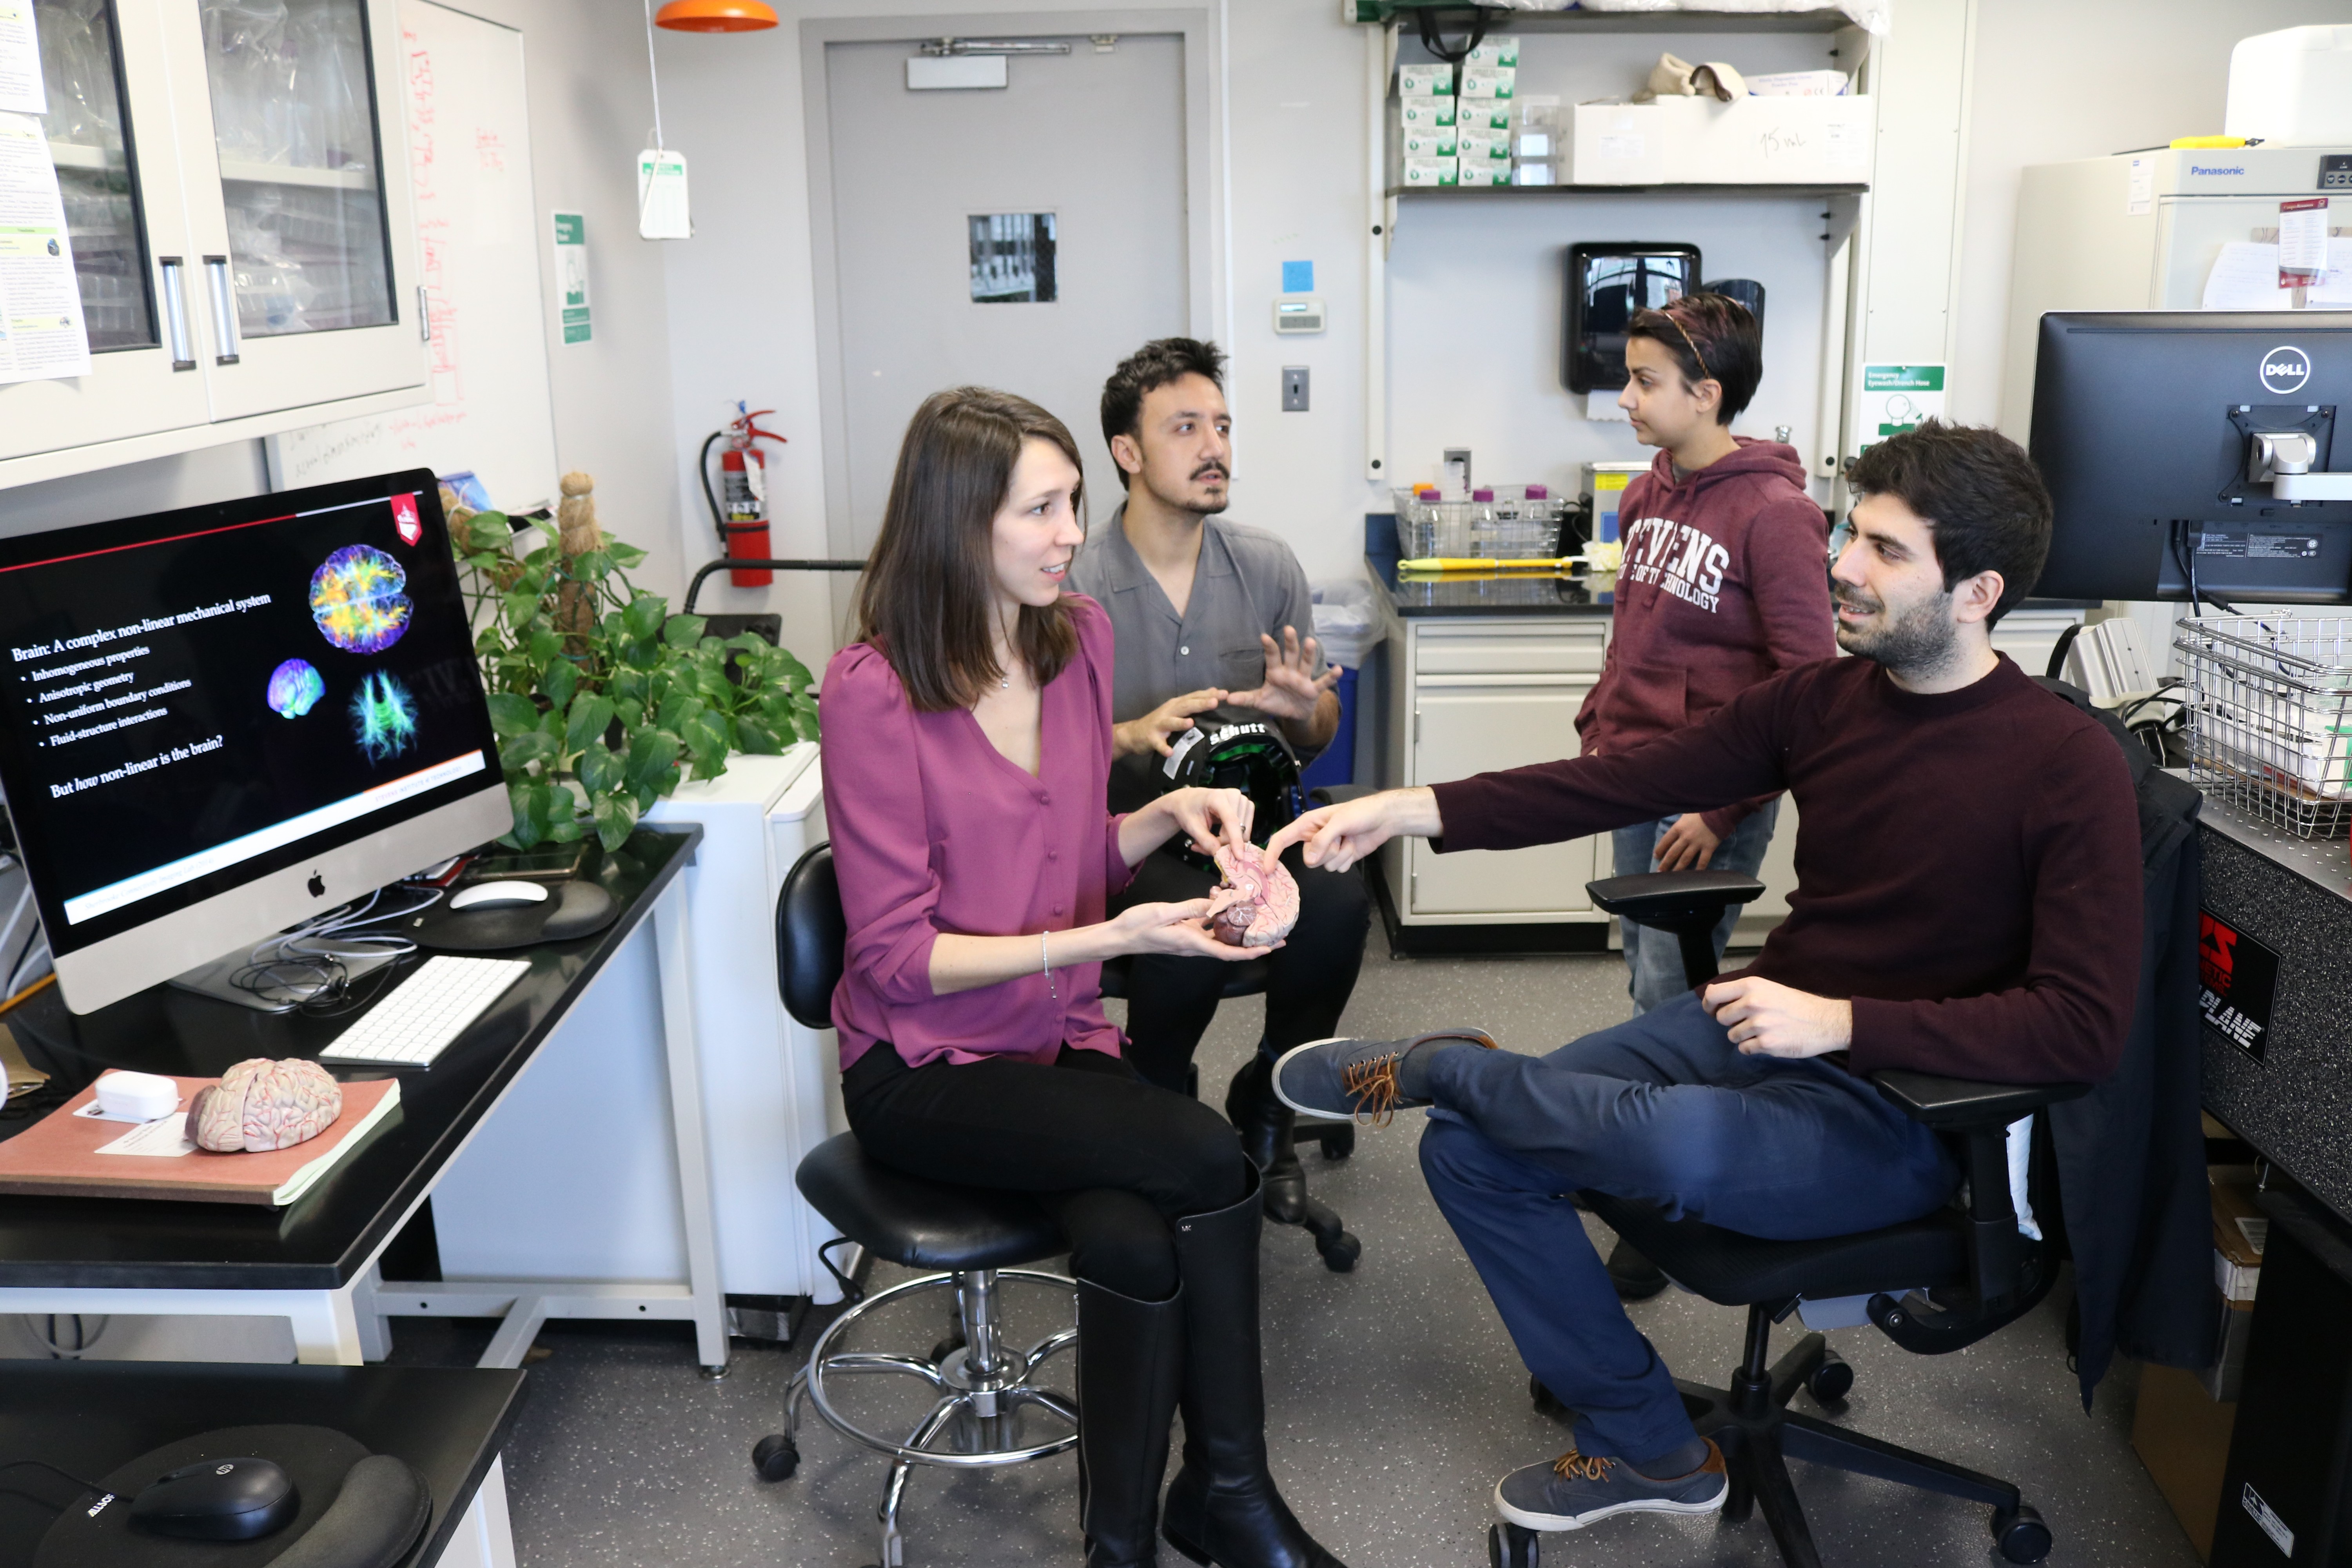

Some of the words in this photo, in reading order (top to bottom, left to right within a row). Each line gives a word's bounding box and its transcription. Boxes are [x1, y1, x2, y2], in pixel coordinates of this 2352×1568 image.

[2191, 166, 2245, 175] Panasonic
[2265, 363, 2305, 376] DELL
[1621, 517, 1730, 595] TEVENS
[11, 644, 51, 662] Brain:
[54, 639, 65, 653] A
[66, 629, 117, 650] complex
[118, 618, 175, 638] non-linear
[176, 599, 235, 624] mechanical
[236, 594, 271, 613] system
[31, 656, 105, 682] Inhomogeneous
[105, 646, 150, 664] properties
[39, 681, 92, 703] Anisotropic
[93, 672, 134, 692] geometry
[43, 701, 105, 725] Non-uniform
[105, 690, 147, 709] boundary
[148, 679, 191, 698] conditions
[49, 720, 118, 746] Fluid-structure
[118, 707, 168, 728] interactions
[1209, 722, 1266, 745] schutt
[50, 782, 74, 798] But
[75, 775, 98, 792] how
[100, 758, 158, 784] non-linear
[159, 752, 171, 765] is
[171, 748, 190, 761] the
[189, 734, 224, 756] brain?
[2199, 958, 2232, 988] NETIC
[216, 1465, 233, 1474] hp
